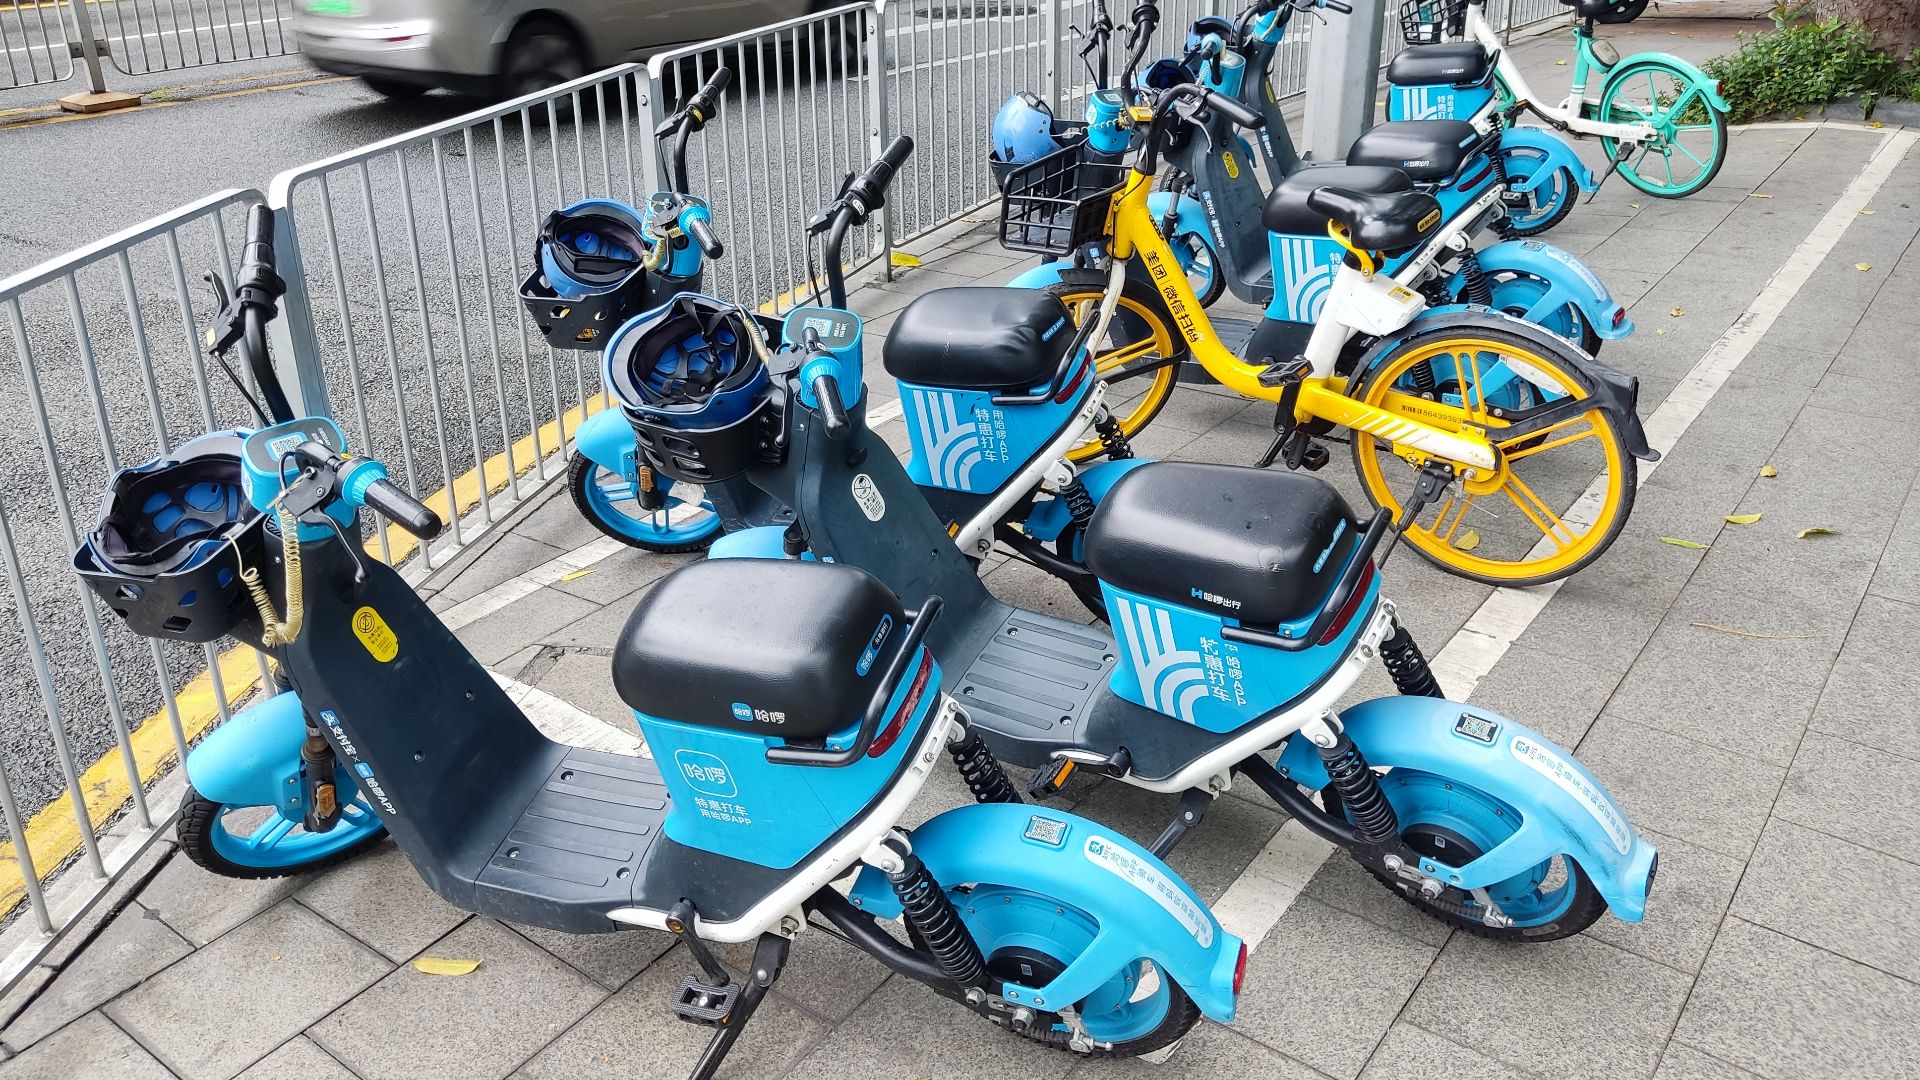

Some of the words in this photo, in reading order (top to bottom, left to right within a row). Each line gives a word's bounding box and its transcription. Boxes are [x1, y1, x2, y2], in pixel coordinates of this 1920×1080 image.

[1144, 250, 1167, 280] 美团
[1163, 285, 1199, 343] 微信扫码
[975, 408, 999, 463] 特惠打车
[993, 410, 1009, 463] 用哈啰APP
[1204, 593, 1242, 610] 哈啰出行
[1200, 637, 1232, 702] 特惠打车
[1225, 643, 1247, 707] 用哈啰APP
[754, 709, 785, 724] 哈啰
[330, 725, 357, 755] 支付宝
[365, 777, 397, 815] 哈啰APP
[684, 763, 726, 785] 哈啰
[695, 797, 748, 816] 特惠打车
[700, 809, 752, 826] 用哈啰APP
